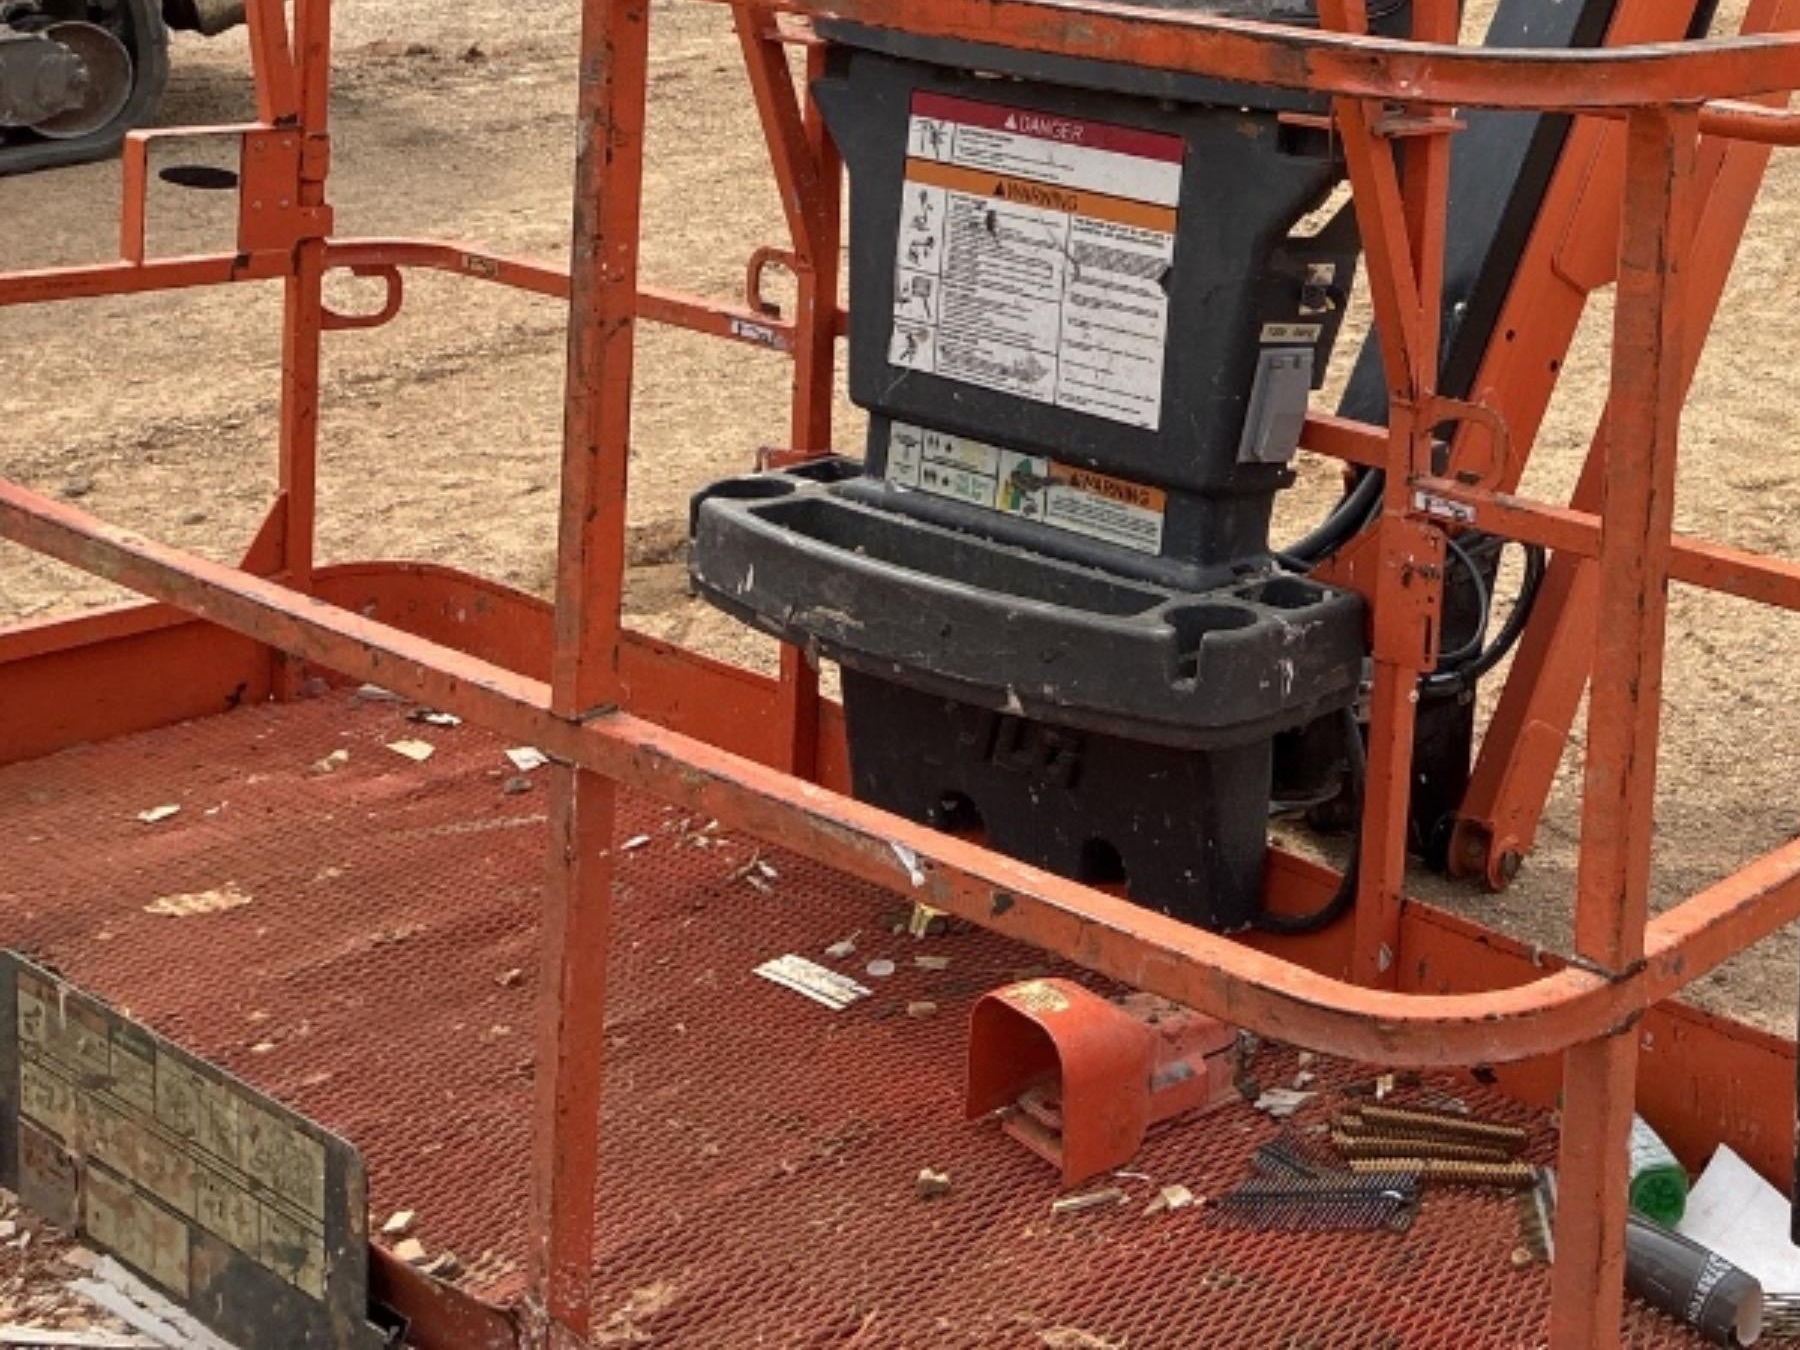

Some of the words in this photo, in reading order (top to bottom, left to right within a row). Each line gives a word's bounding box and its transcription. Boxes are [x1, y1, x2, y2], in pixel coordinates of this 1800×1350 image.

[1018, 117, 1085, 140] DANGER
[1006, 182, 1079, 211] WARNING
[1078, 475, 1151, 507] WARNING
